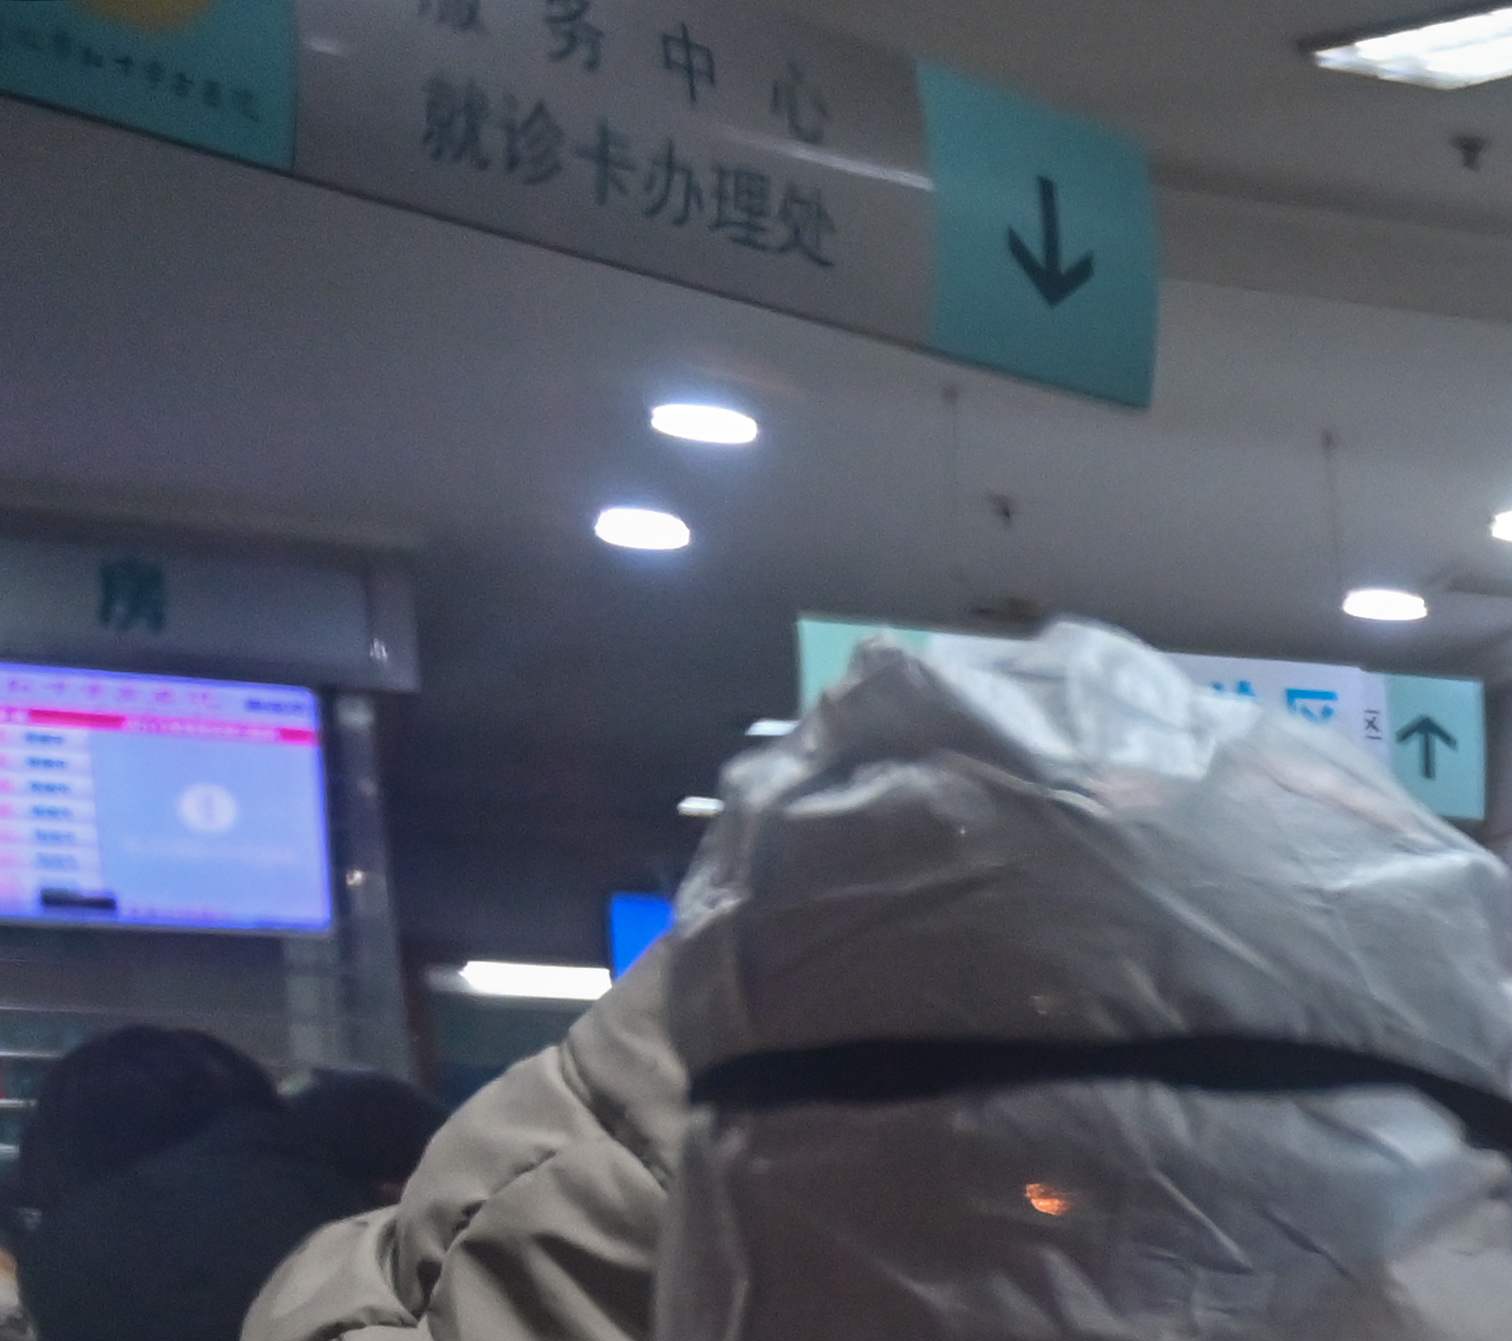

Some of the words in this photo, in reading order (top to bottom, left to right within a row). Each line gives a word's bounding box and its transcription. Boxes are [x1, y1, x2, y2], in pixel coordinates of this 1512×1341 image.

[420, 70, 836, 268] 就诊卡办理处
